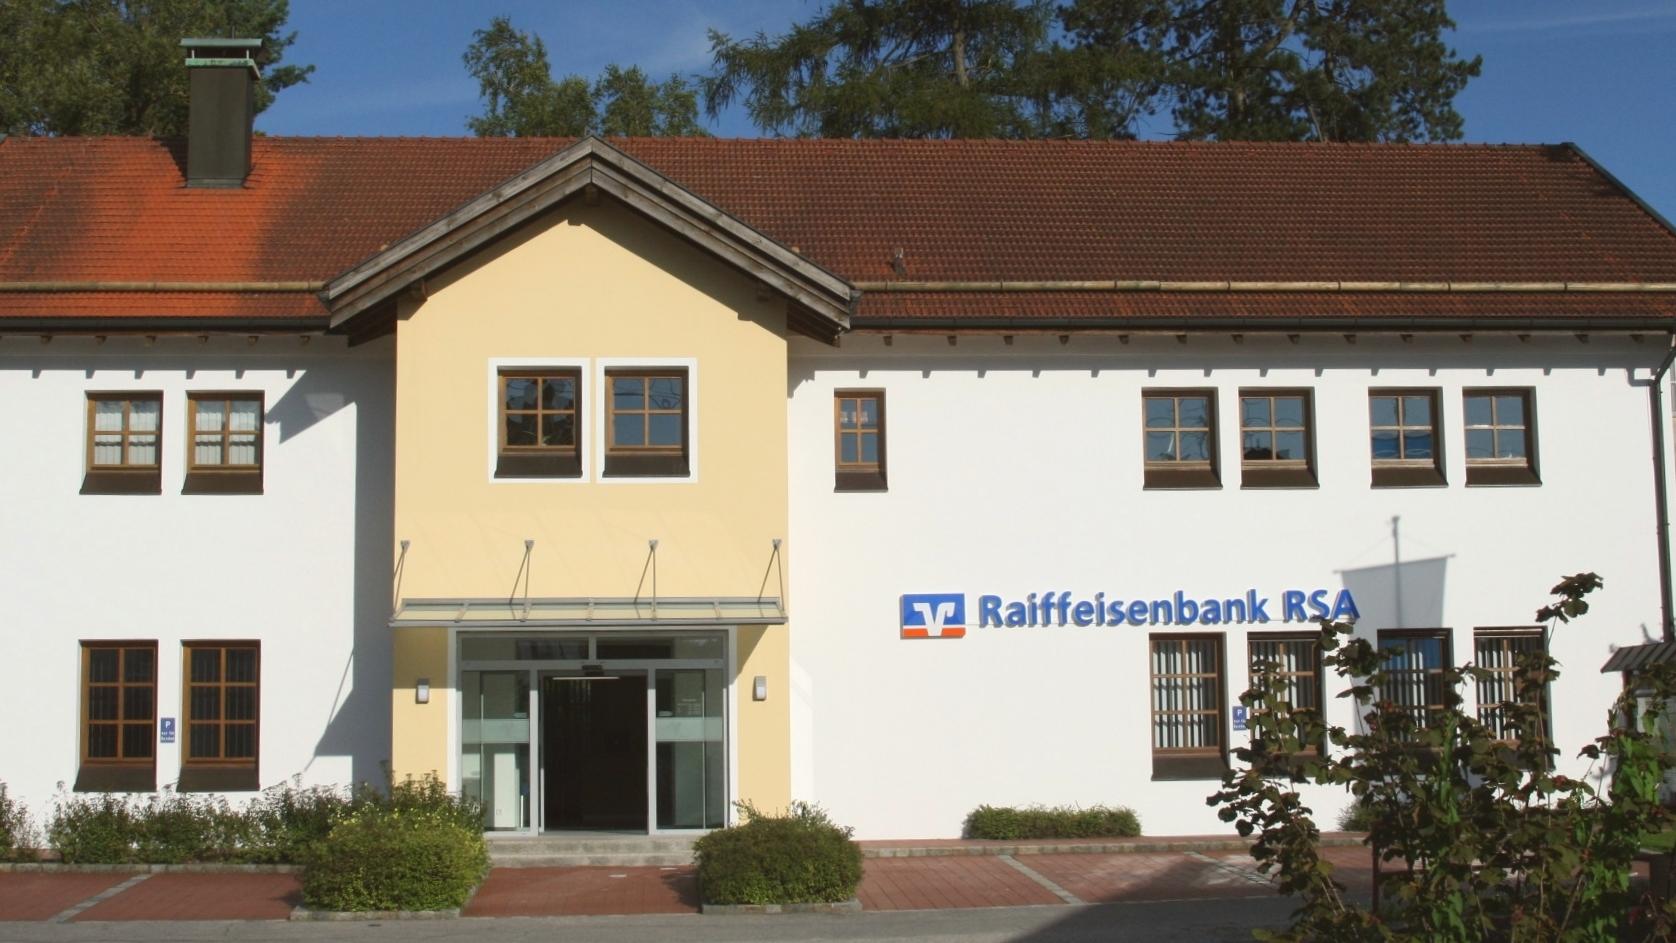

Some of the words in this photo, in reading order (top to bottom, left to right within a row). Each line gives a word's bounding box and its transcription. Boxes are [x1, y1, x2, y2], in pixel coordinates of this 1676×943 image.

[978, 589, 1270, 627] Raiffeisenbank
[1284, 588, 1358, 622] RSA
[1237, 709, 1243, 717] P
[165, 720, 171, 729] P
